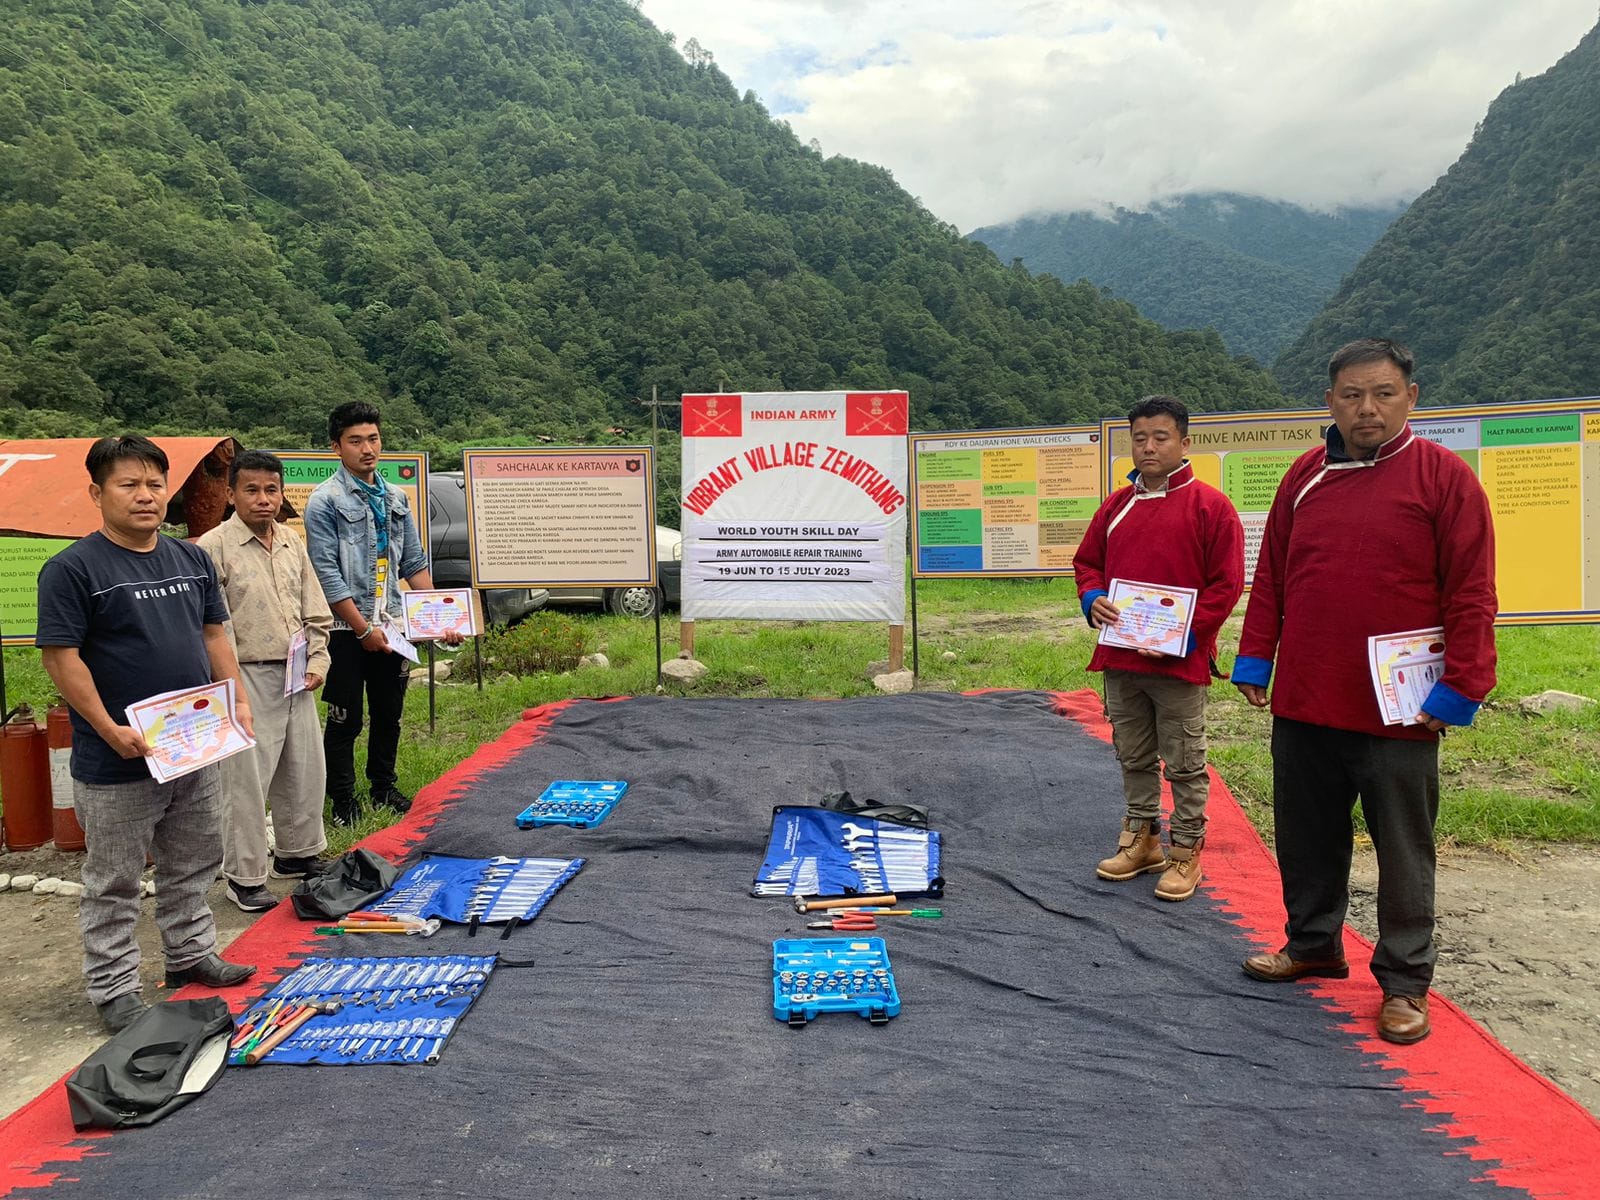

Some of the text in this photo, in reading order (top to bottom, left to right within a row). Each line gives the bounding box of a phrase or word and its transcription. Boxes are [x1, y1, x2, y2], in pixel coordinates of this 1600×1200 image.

[751, 410, 836, 419] INDIAN ARMY
[1506, 427, 1534, 435] PARADE
[1545, 425, 1574, 433] KARWAI
[1001, 438, 1021, 446] HONE
[1022, 437, 1043, 445] WALE
[1044, 436, 1072, 444] CHECKS
[1233, 430, 1277, 443] MAINT
[1281, 429, 1313, 441] TASK
[283, 467, 304, 477] REA
[496, 462, 620, 472] SAHCHALAK KE KARTAVYA
[683, 442, 905, 516] VIBRANT VILLAGE ZEMITHANG
[718, 527, 859, 535] WORLD YOUTH SKILL DAY
[716, 549, 863, 558] ARMY AUTOMOBILE REPAIR TRAINING
[719, 567, 850, 576] 19 JUN TO 15 JULY 2023
